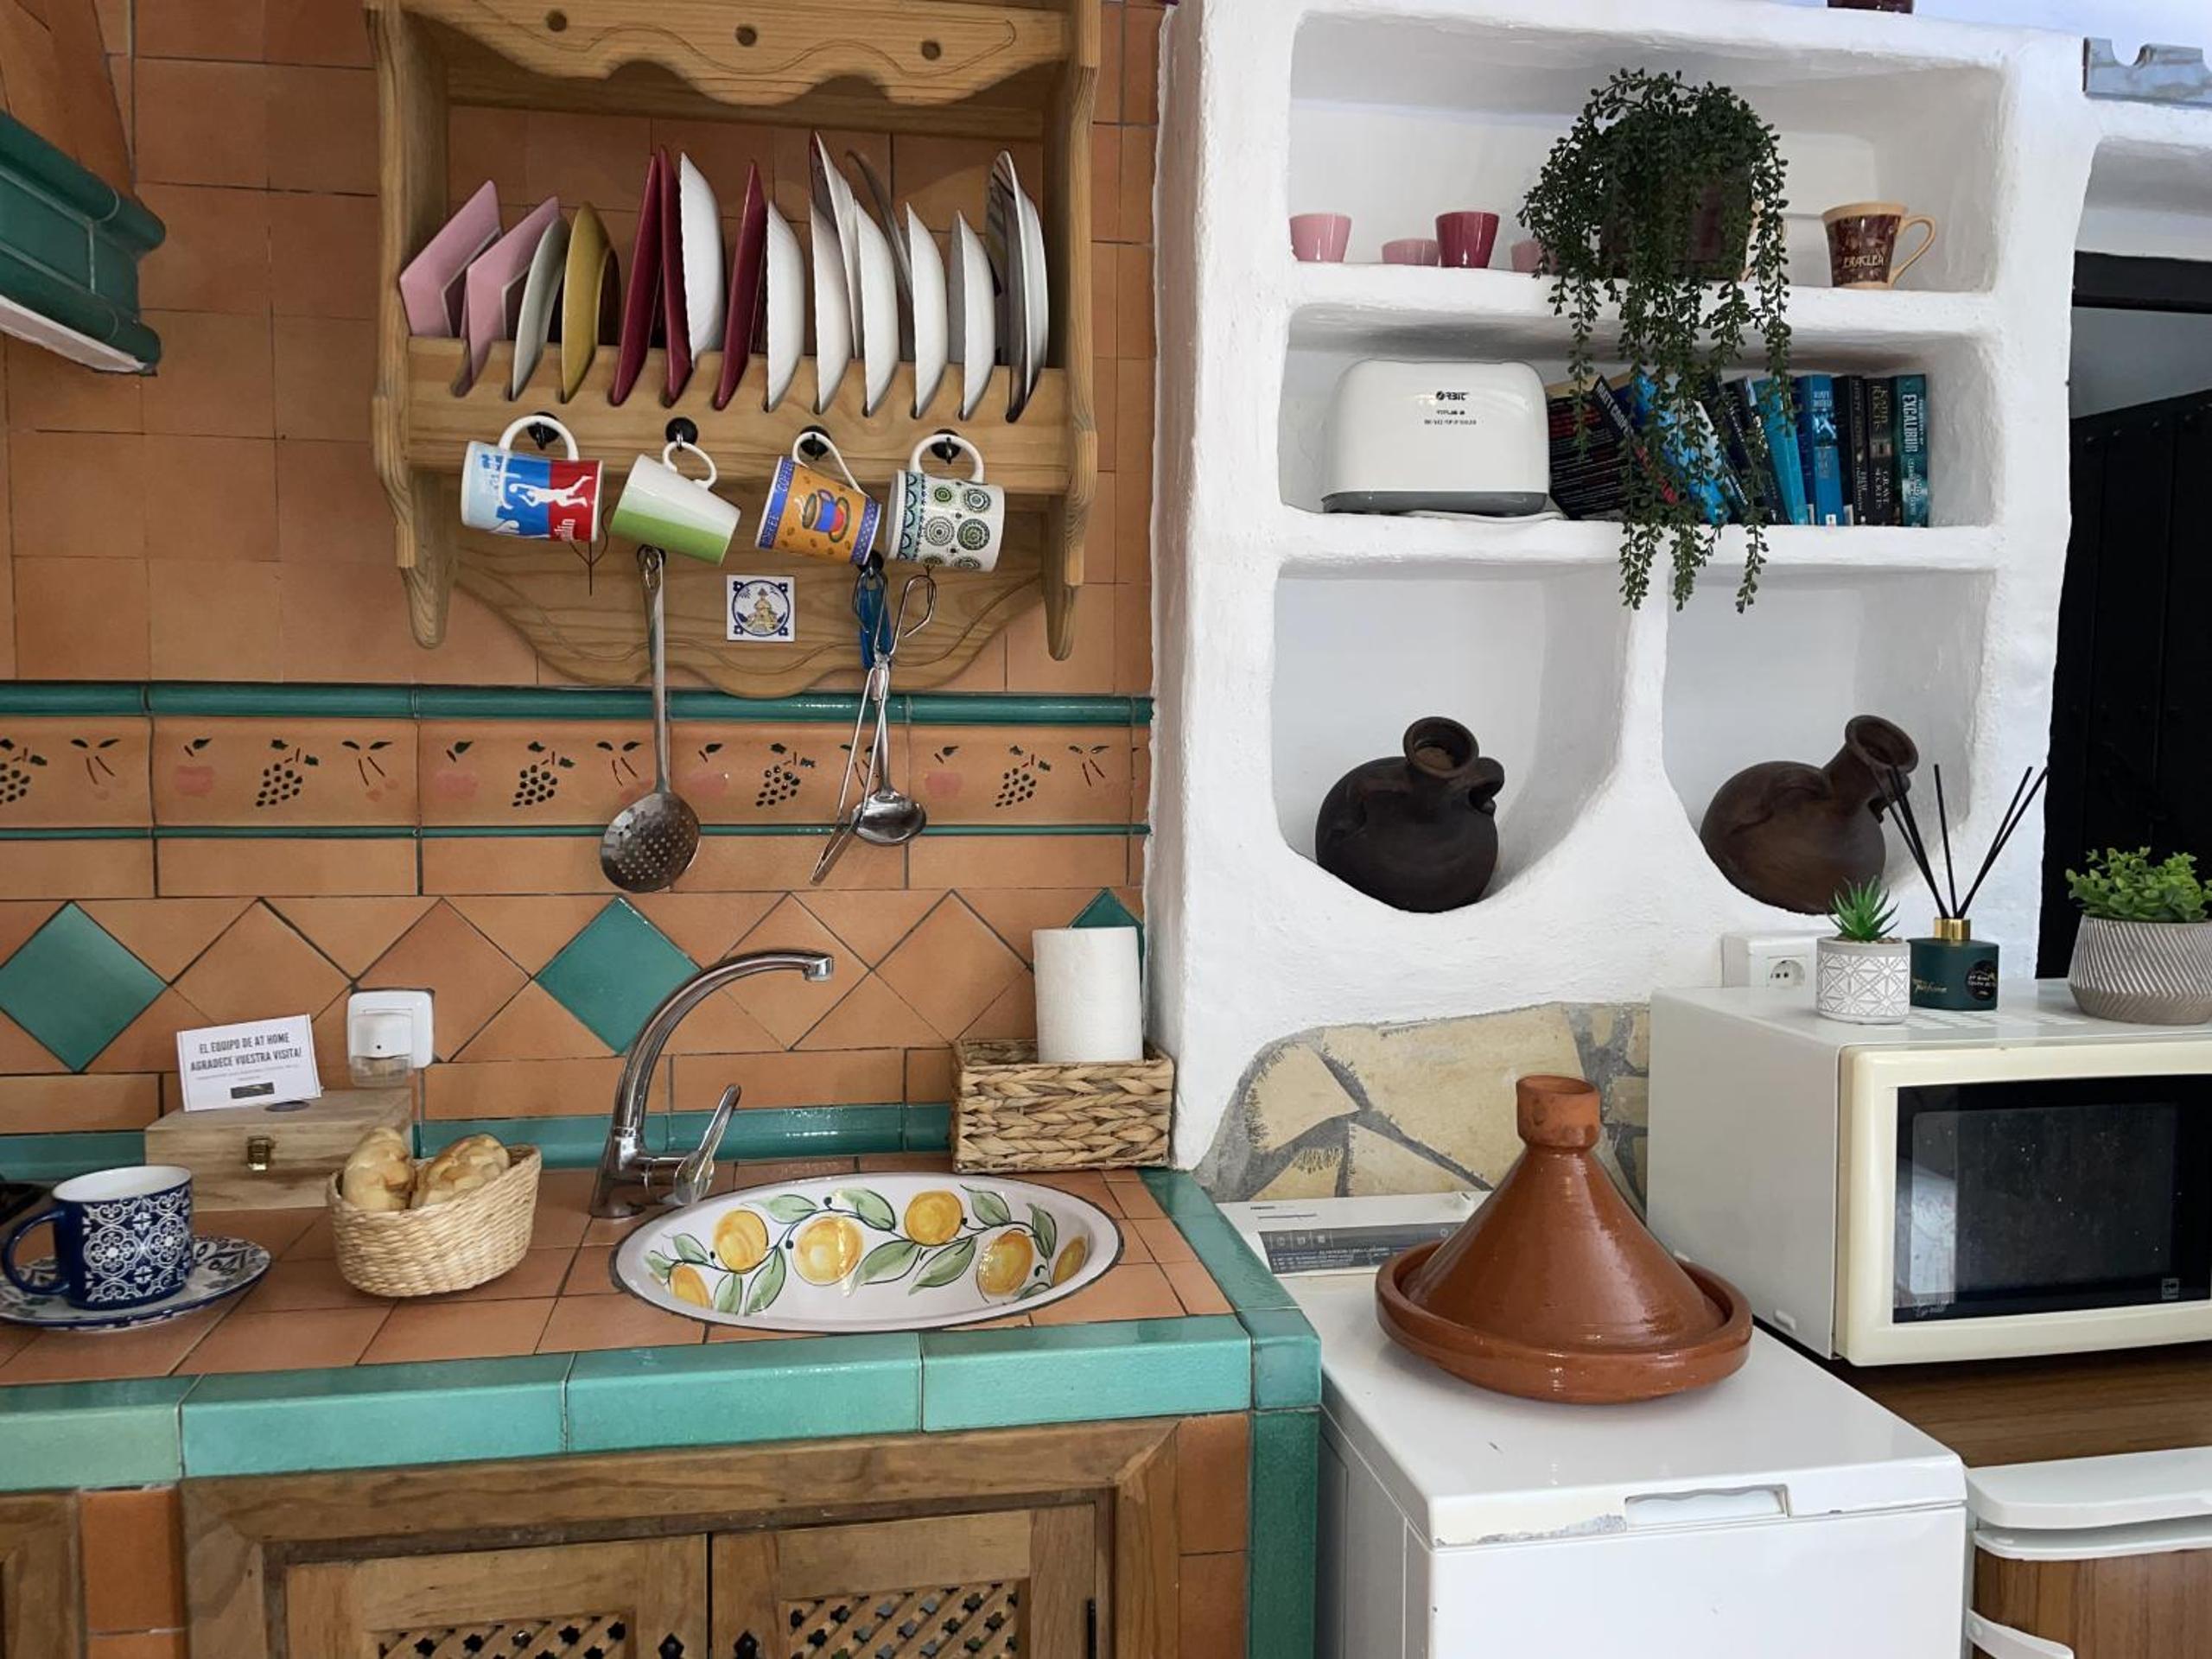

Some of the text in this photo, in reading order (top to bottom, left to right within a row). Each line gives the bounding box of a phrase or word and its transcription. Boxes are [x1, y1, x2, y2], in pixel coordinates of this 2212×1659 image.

[1902, 394, 1918, 452] EXCALIBUR
[200, 1032, 289, 1054] EL EQUIPO DE AT HOME
[190, 1058, 233, 1072] AGRADECE
[235, 1052, 271, 1066] VUESTRA
